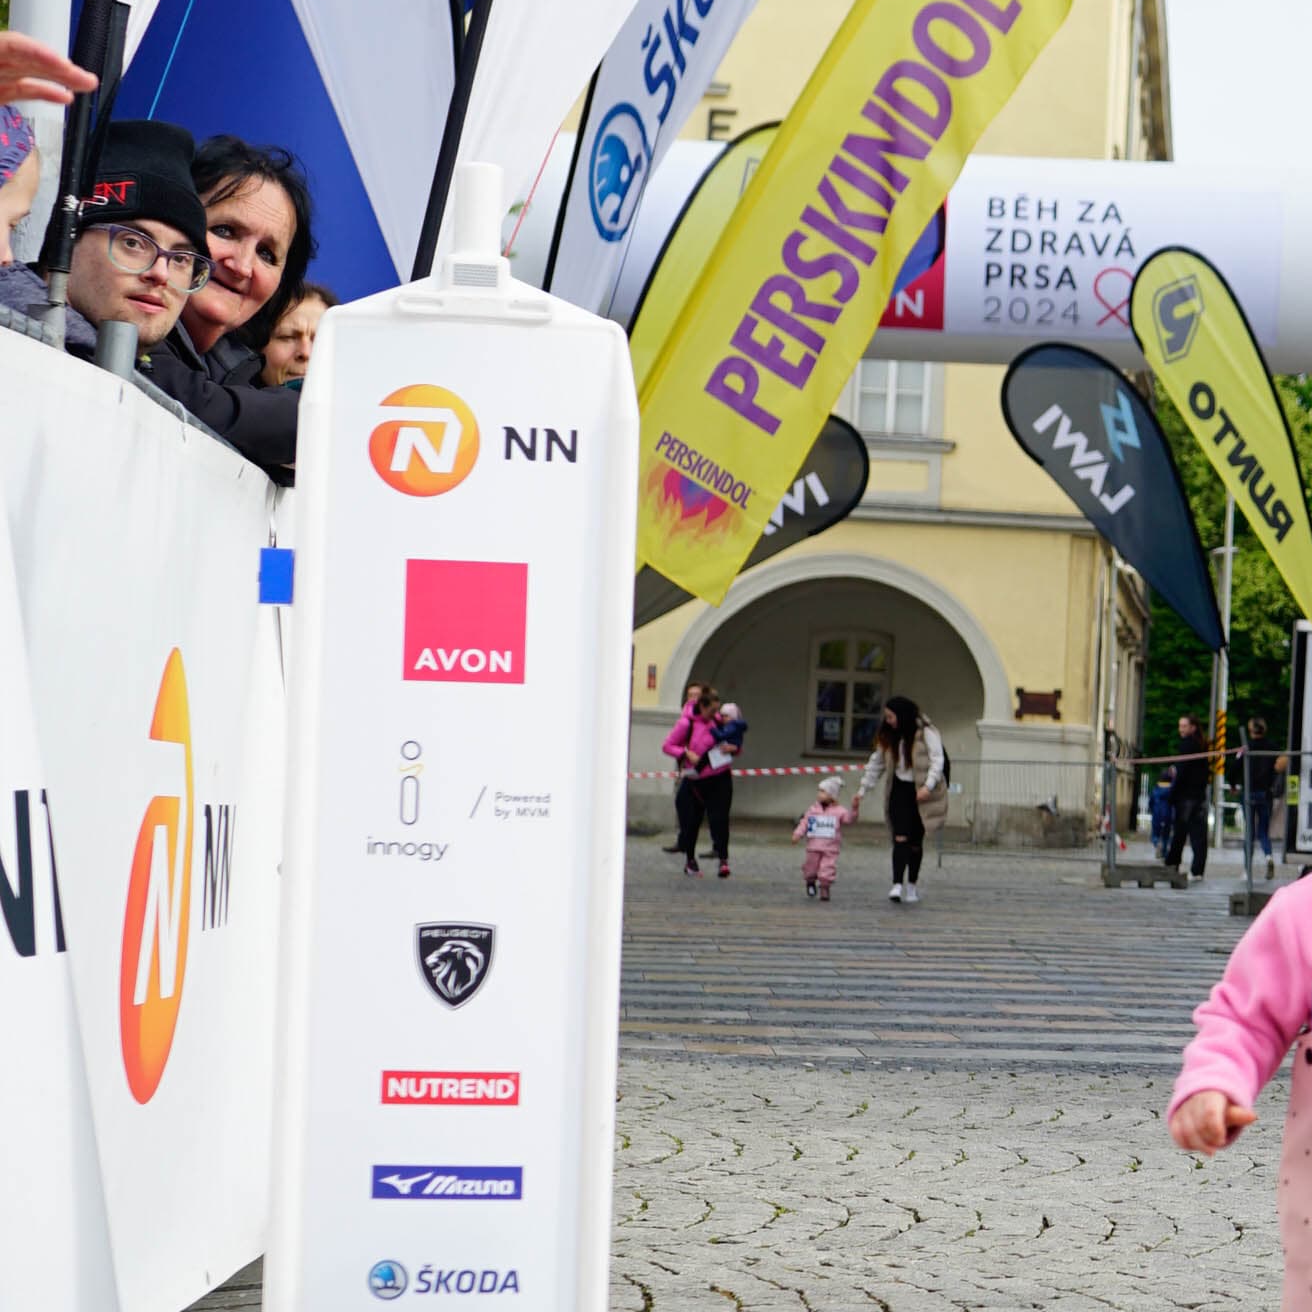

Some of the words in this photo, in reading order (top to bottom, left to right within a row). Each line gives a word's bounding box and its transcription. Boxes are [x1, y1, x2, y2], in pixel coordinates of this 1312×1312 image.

[987, 192, 1059, 222] BĚH
[1077, 200, 1123, 224] ZA
[985, 226, 1136, 259] ZDRAVÁ
[984, 261, 1077, 291] PRSA
[983, 295, 1081, 327] 2024
[502, 426, 578, 463] NN
[655, 430, 752, 510] PERSKINDOL
[414, 647, 513, 673] AVON
[494, 791, 552, 805] Powered
[494, 806, 511, 819] by
[516, 807, 552, 819] MVM
[366, 835, 450, 862] innogy
[387, 1077, 516, 1100] NUTREND
[413, 1264, 520, 1294] ŠKODA
